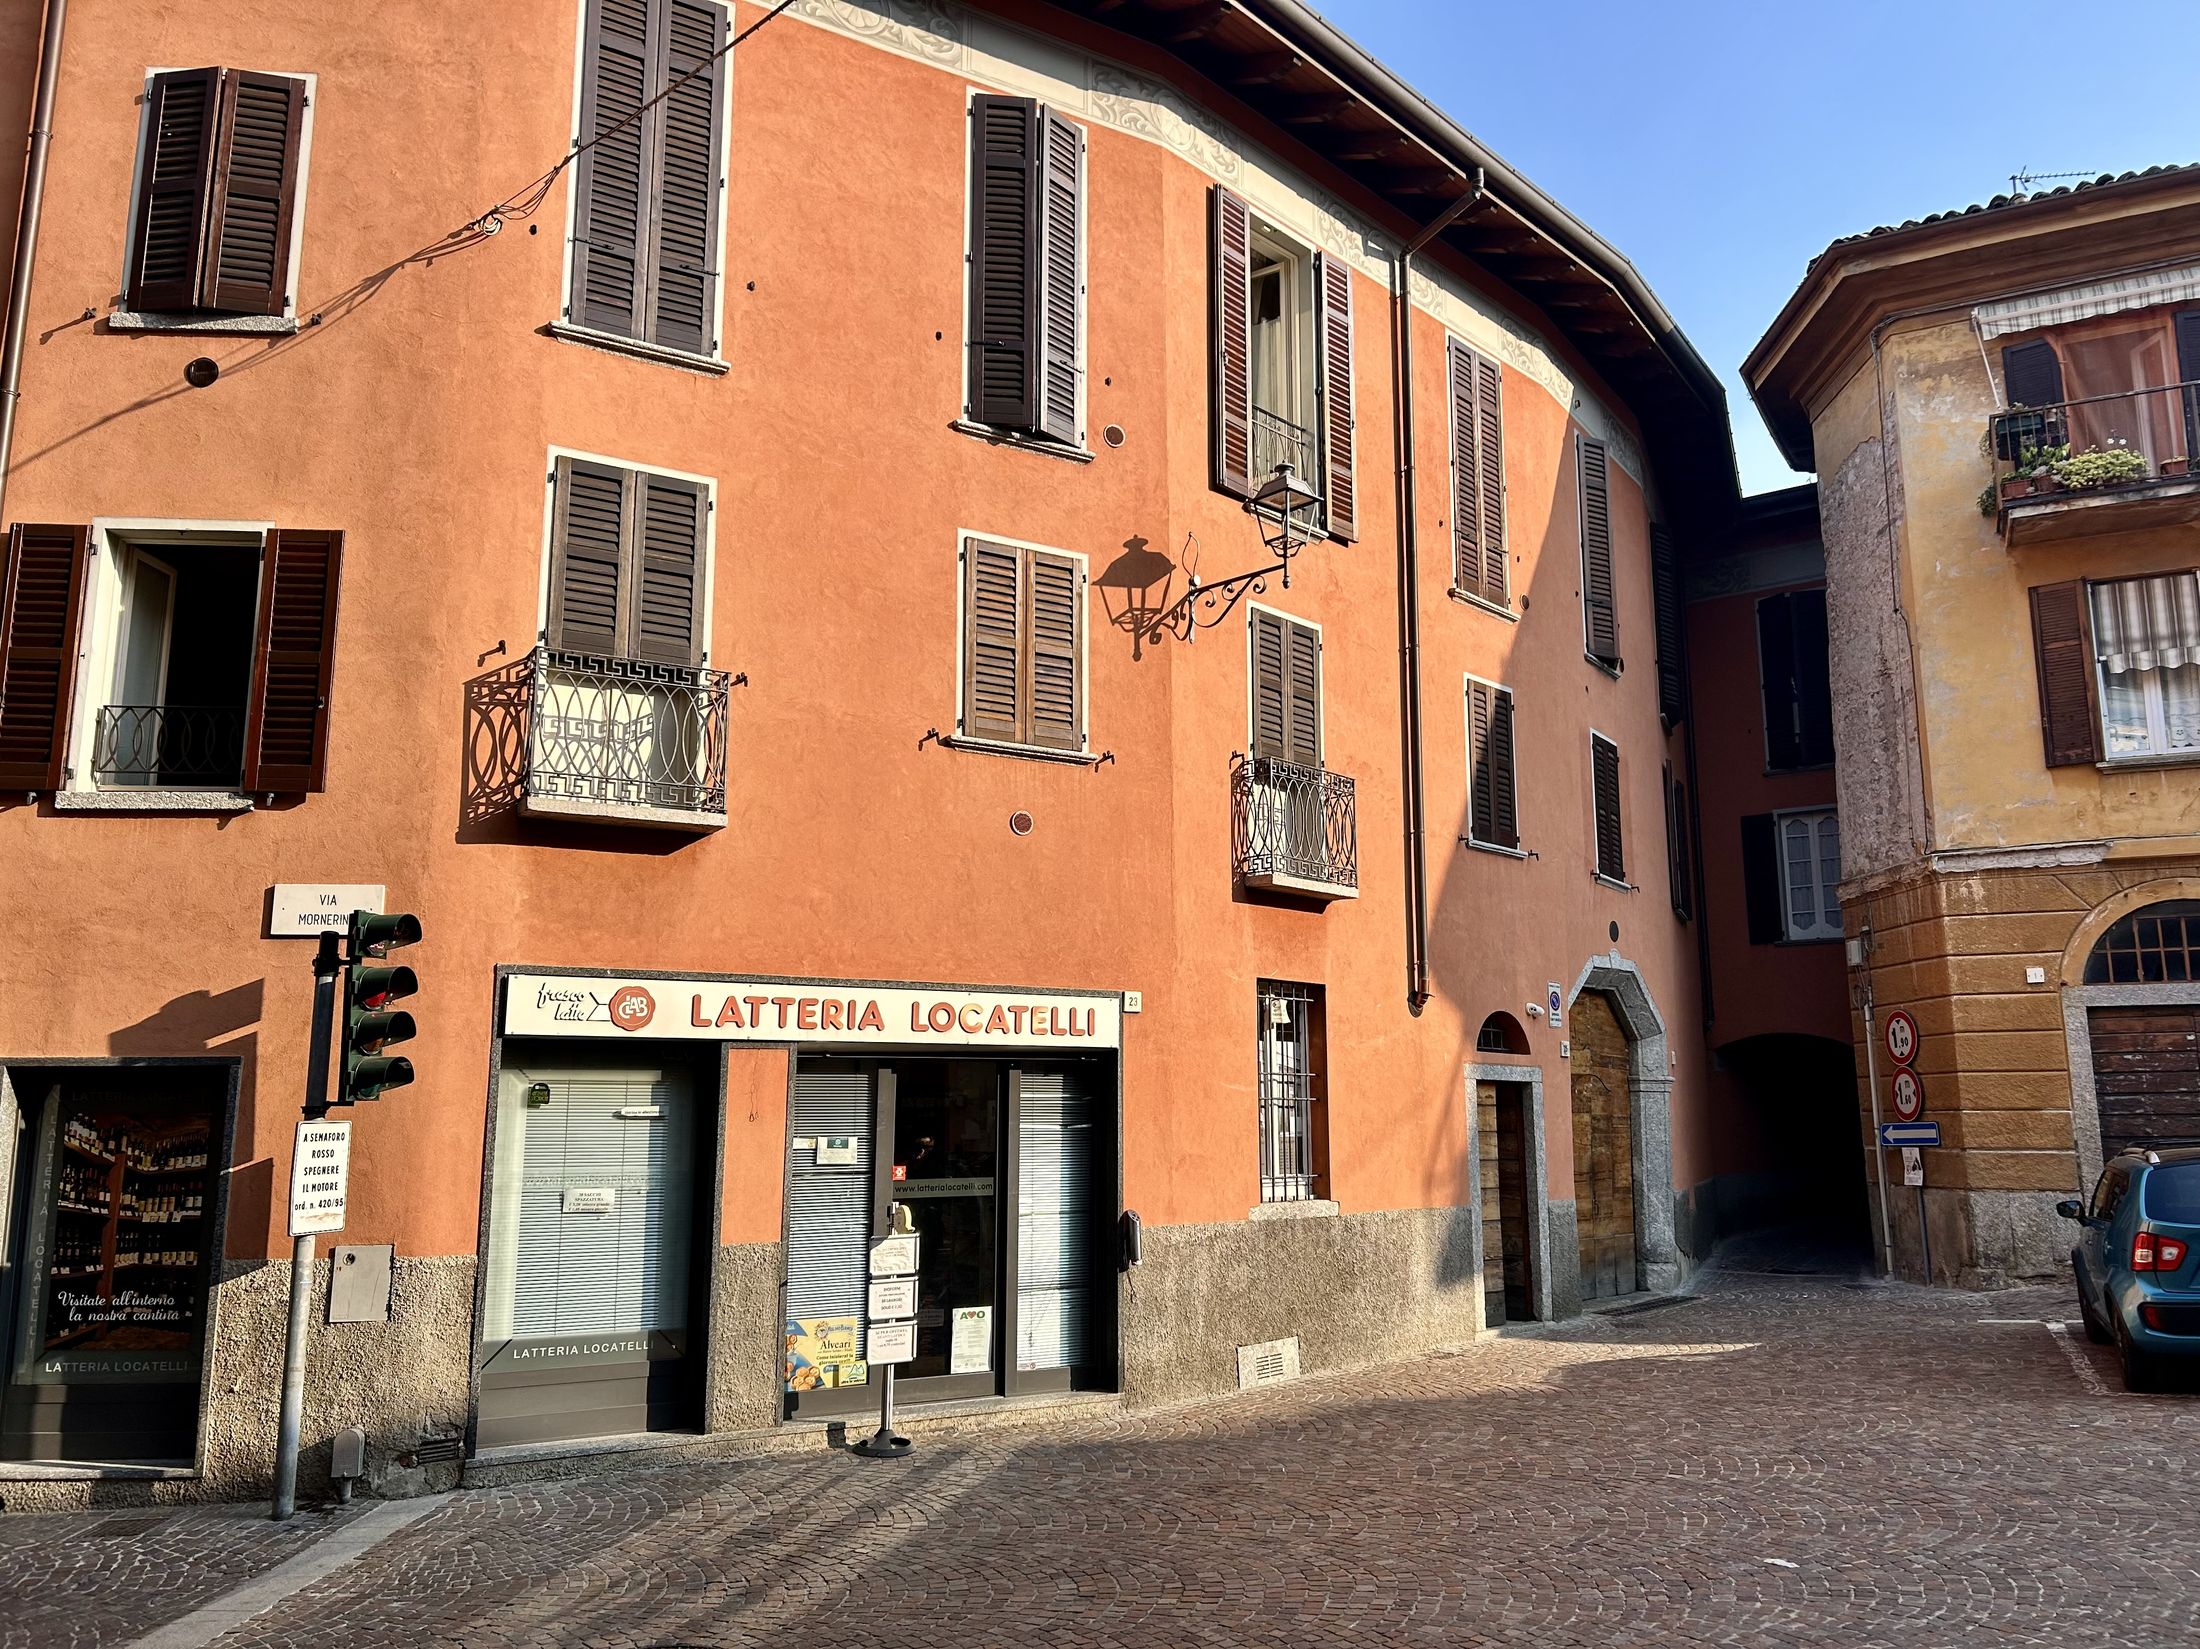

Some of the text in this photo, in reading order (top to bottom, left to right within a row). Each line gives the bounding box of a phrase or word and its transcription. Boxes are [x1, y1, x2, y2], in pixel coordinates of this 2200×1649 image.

[319, 894, 338, 906] VIA
[298, 913, 349, 926] MORNERIN
[1128, 996, 1138, 1007] 23
[690, 993, 1096, 1037] LATTERIA LOCATELLI
[303, 1132, 346, 1142] A SEMAFORO
[312, 1149, 335, 1159] ROSSO
[39, 1113, 58, 1216] LATTERIA
[303, 1165, 340, 1176] SPEGNERE
[302, 1182, 338, 1193] IL MOTORE
[894, 1182, 993, 1193] www.latterialocatelli.com
[294, 1197, 344, 1211] ord. n. 420/95
[28, 1231, 45, 1350] LOCATELLI
[57, 1290, 176, 1307] Visitate all'interno
[68, 1306, 180, 1322] la nostra cantina
[513, 1340, 654, 1359] LATTERIA LOCATELLI
[45, 1360, 188, 1373] LATTERIA LOCATELLI
